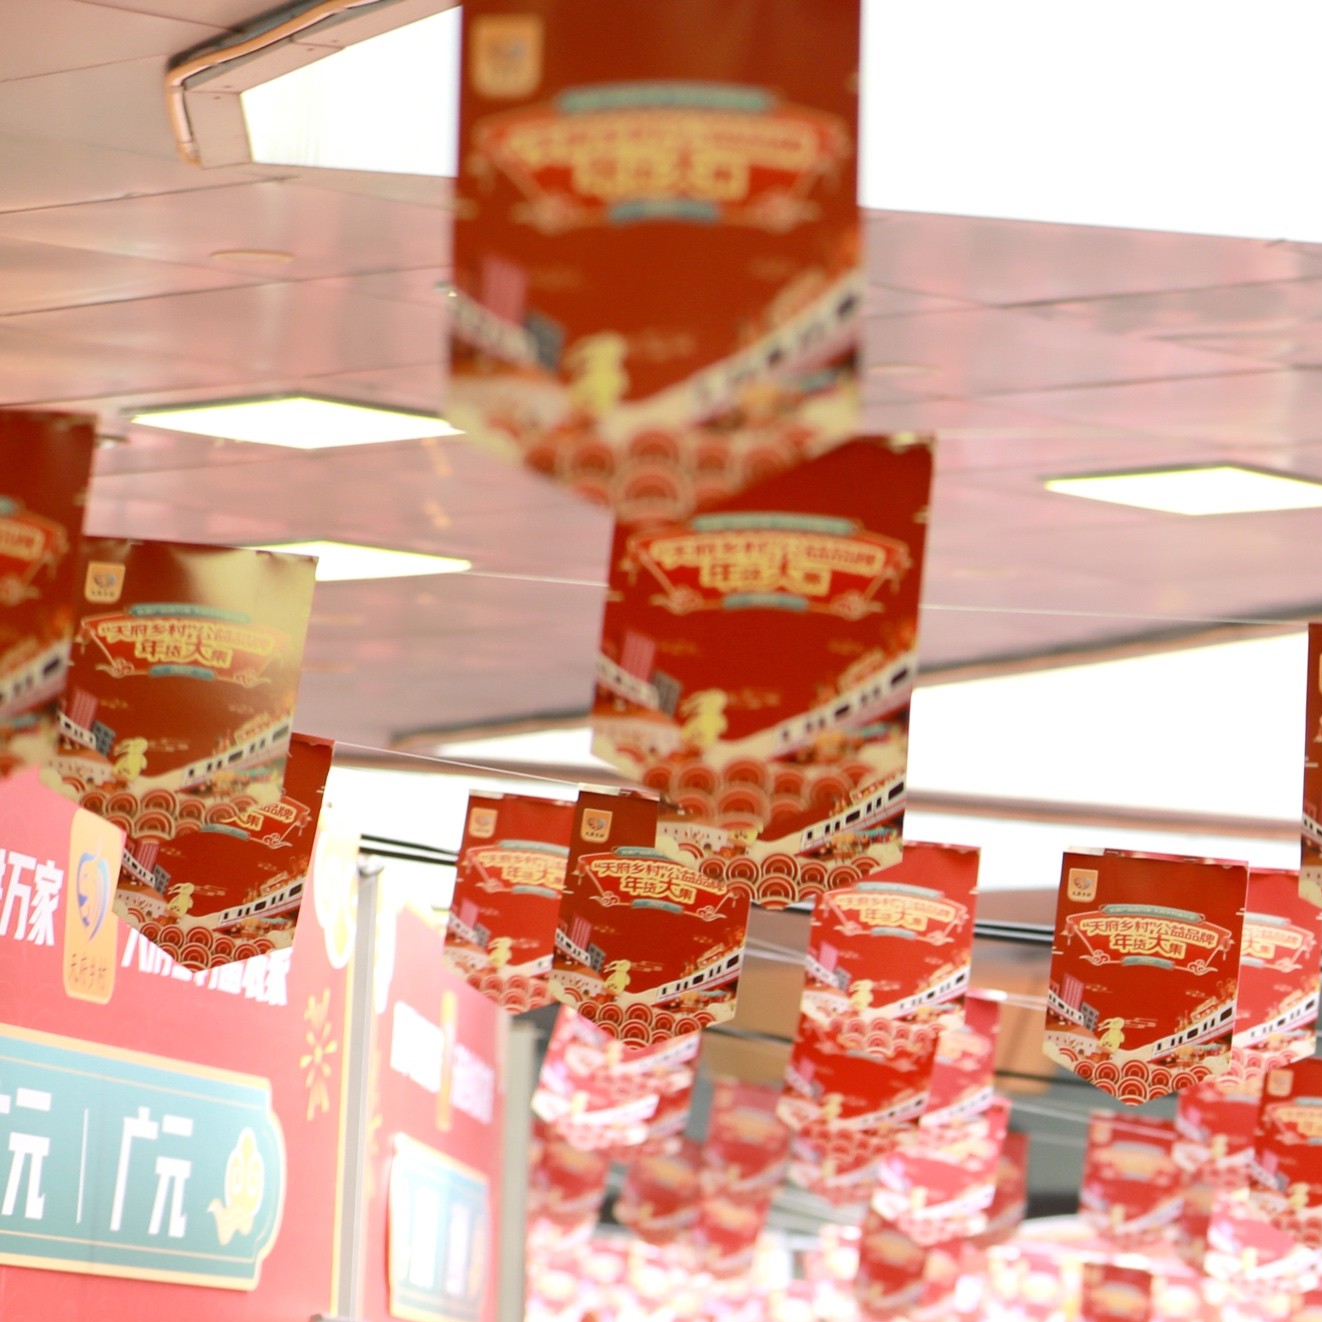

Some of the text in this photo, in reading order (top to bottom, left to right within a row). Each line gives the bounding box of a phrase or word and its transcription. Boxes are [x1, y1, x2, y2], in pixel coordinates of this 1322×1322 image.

[0, 848, 64, 947] 万家
[0, 1086, 194, 1238] 元 广元
